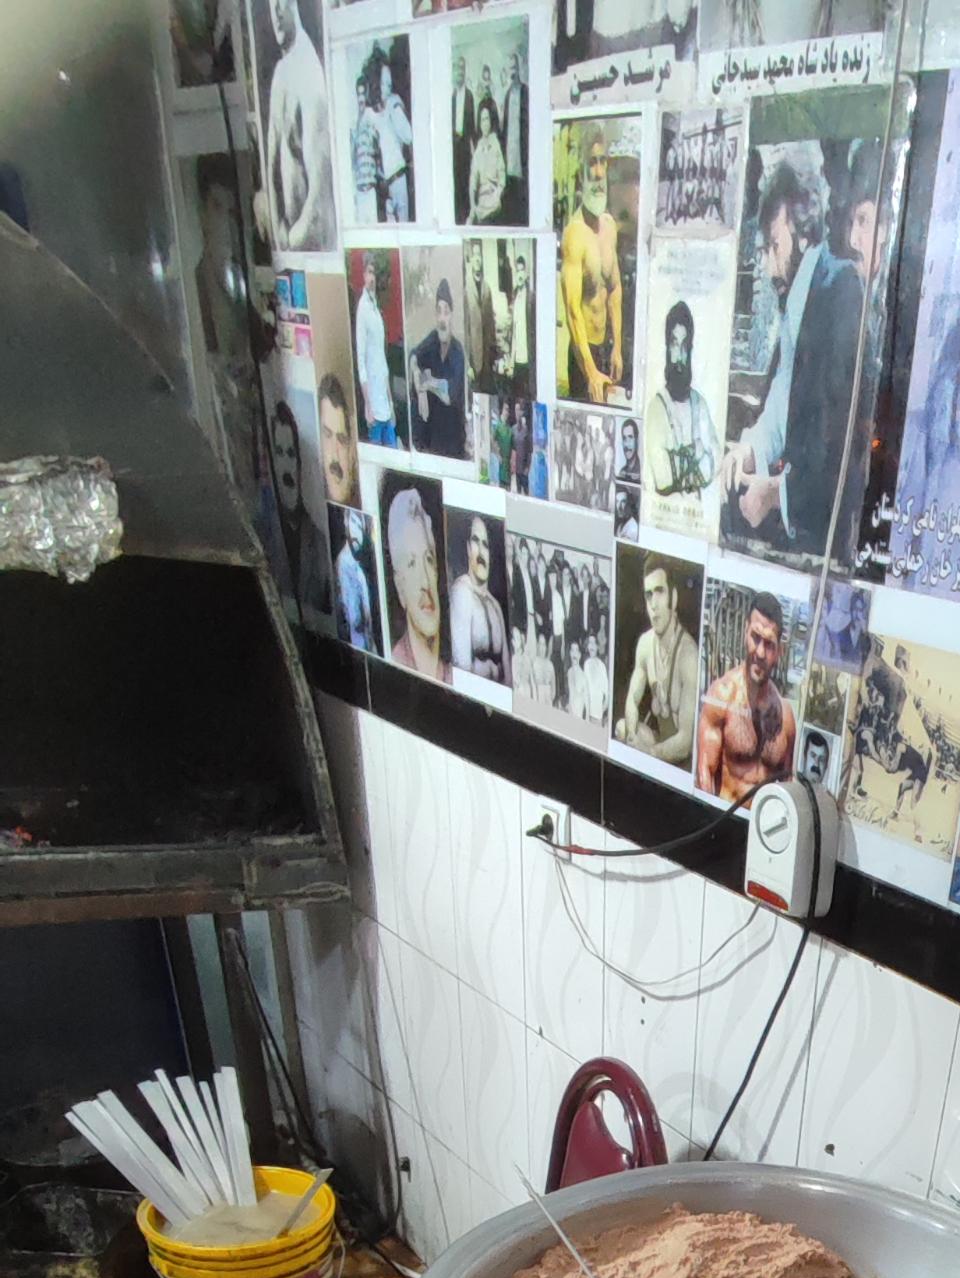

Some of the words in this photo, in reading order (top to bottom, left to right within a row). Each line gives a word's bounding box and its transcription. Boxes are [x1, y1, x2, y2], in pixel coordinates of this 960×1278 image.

[623, 47, 672, 94] مرشد
[762, 53, 794, 85] محمد
[821, 40, 839, 83] باد
[842, 35, 872, 84] زنده
[570, 64, 620, 106] حسین
[871, 491, 915, 535] کردستان
[912, 497, 938, 537] نامی
[929, 548, 952, 587] خان
